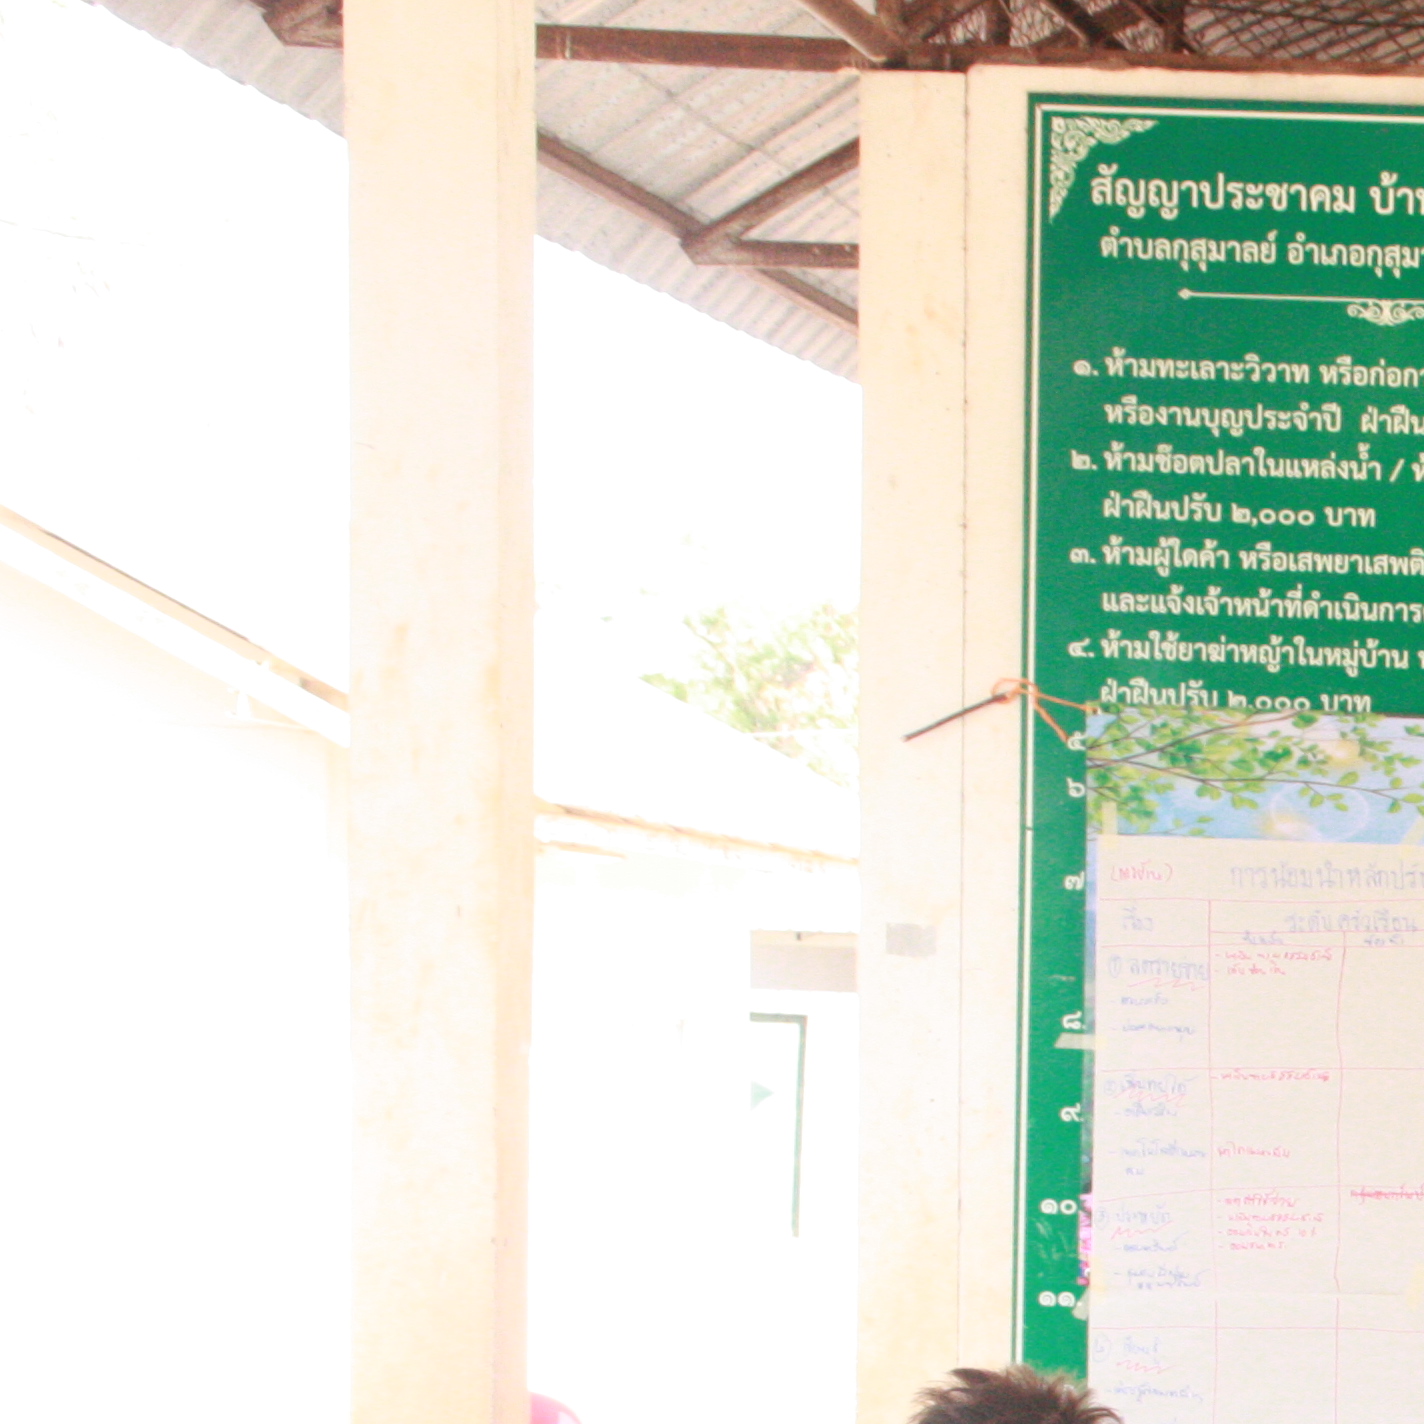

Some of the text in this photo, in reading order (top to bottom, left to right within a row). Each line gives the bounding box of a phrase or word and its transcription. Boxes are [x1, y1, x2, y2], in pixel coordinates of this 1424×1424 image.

[1091, 165, 1355, 220] สัญญาประชาคม
[1100, 226, 1277, 271] ตำบลกุสุมาลย์
[1073, 360, 1098, 376] ๑.
[1104, 343, 1310, 383] ห้ามทะเลาะวิวาท
[1104, 394, 1341, 437] หรืองานบุญประจำปี
[1103, 488, 1375, 527] ฝ่าฝืนปรับ ๒,๐๐๐ บาท
[1102, 533, 1229, 577] ห้ามผู้ใดค้า
[1067, 638, 1094, 657] ๔.
